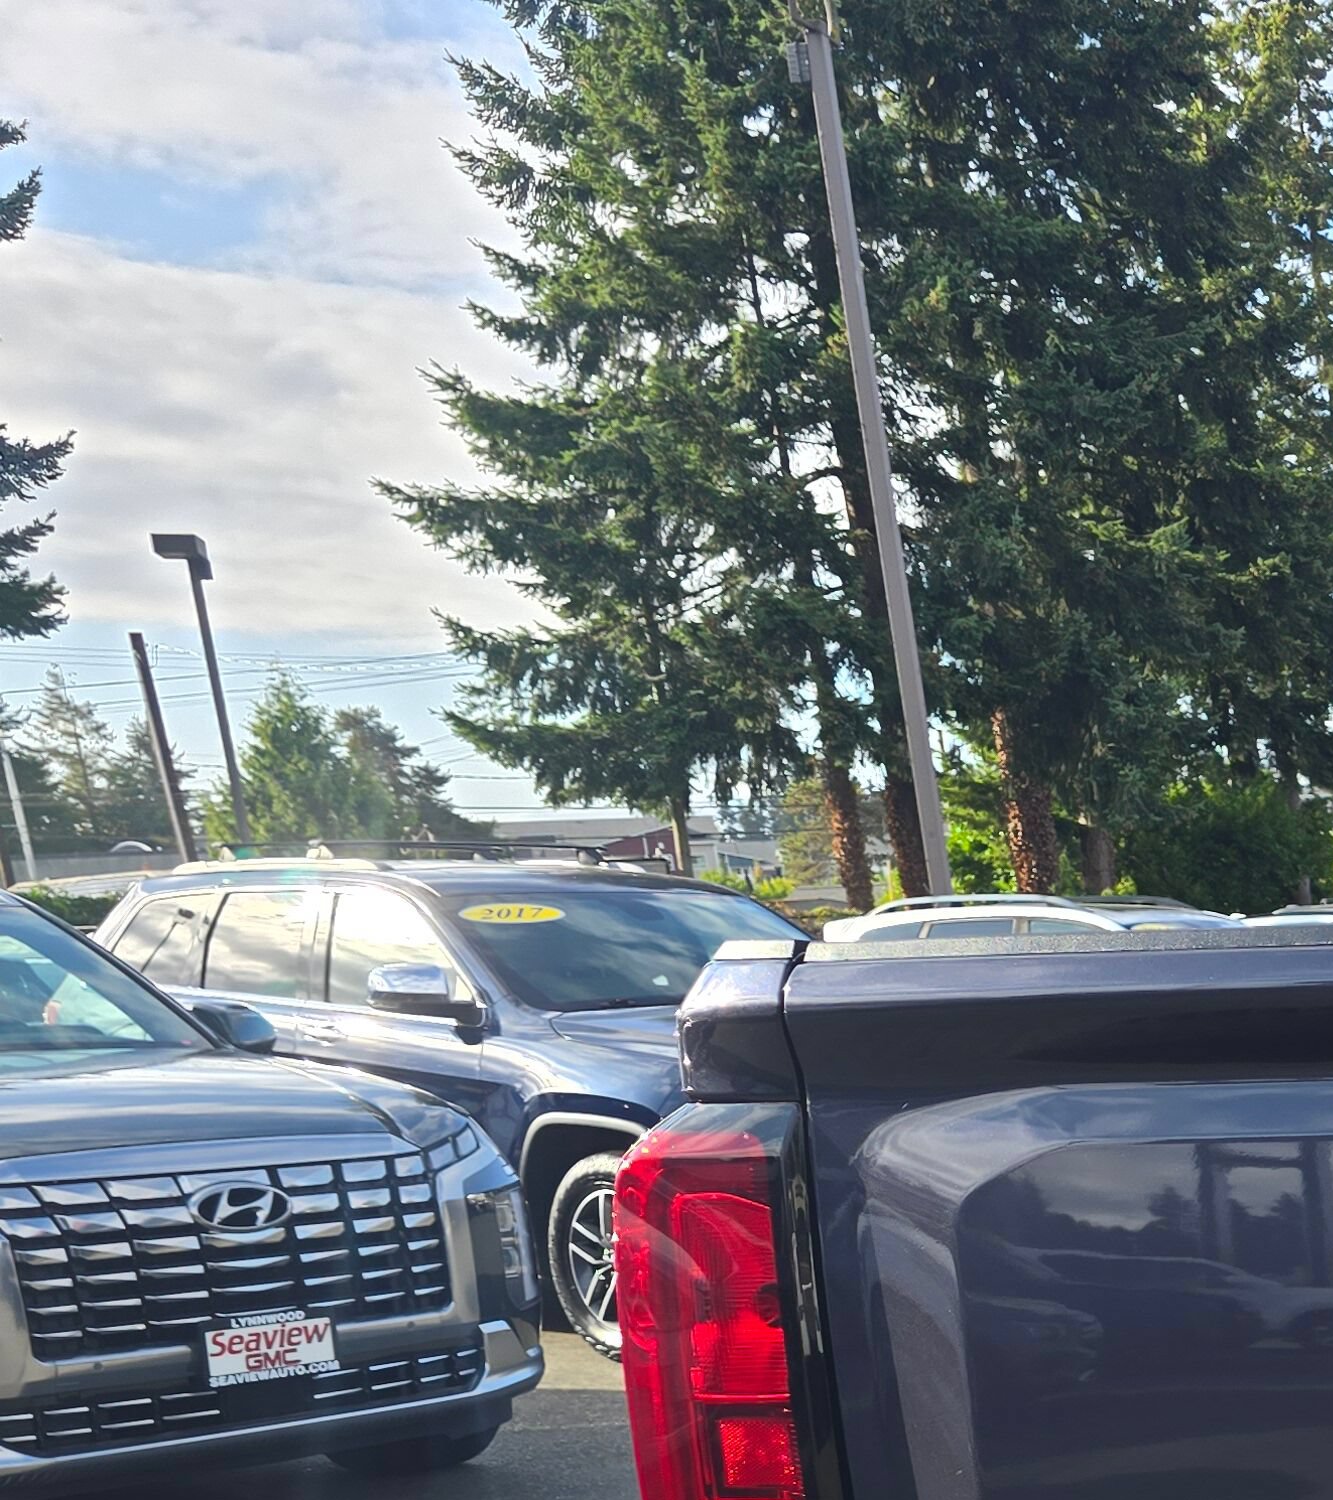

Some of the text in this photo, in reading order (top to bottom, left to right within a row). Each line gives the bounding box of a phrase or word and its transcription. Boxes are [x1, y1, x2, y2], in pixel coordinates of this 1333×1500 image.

[481, 907, 544, 920] 2017
[230, 1310, 305, 1328] LYNNWOOD
[209, 1323, 331, 1357] Seaview
[246, 1349, 302, 1371] GMC
[209, 1360, 340, 1387] SEAVIEWAUTO.COM
